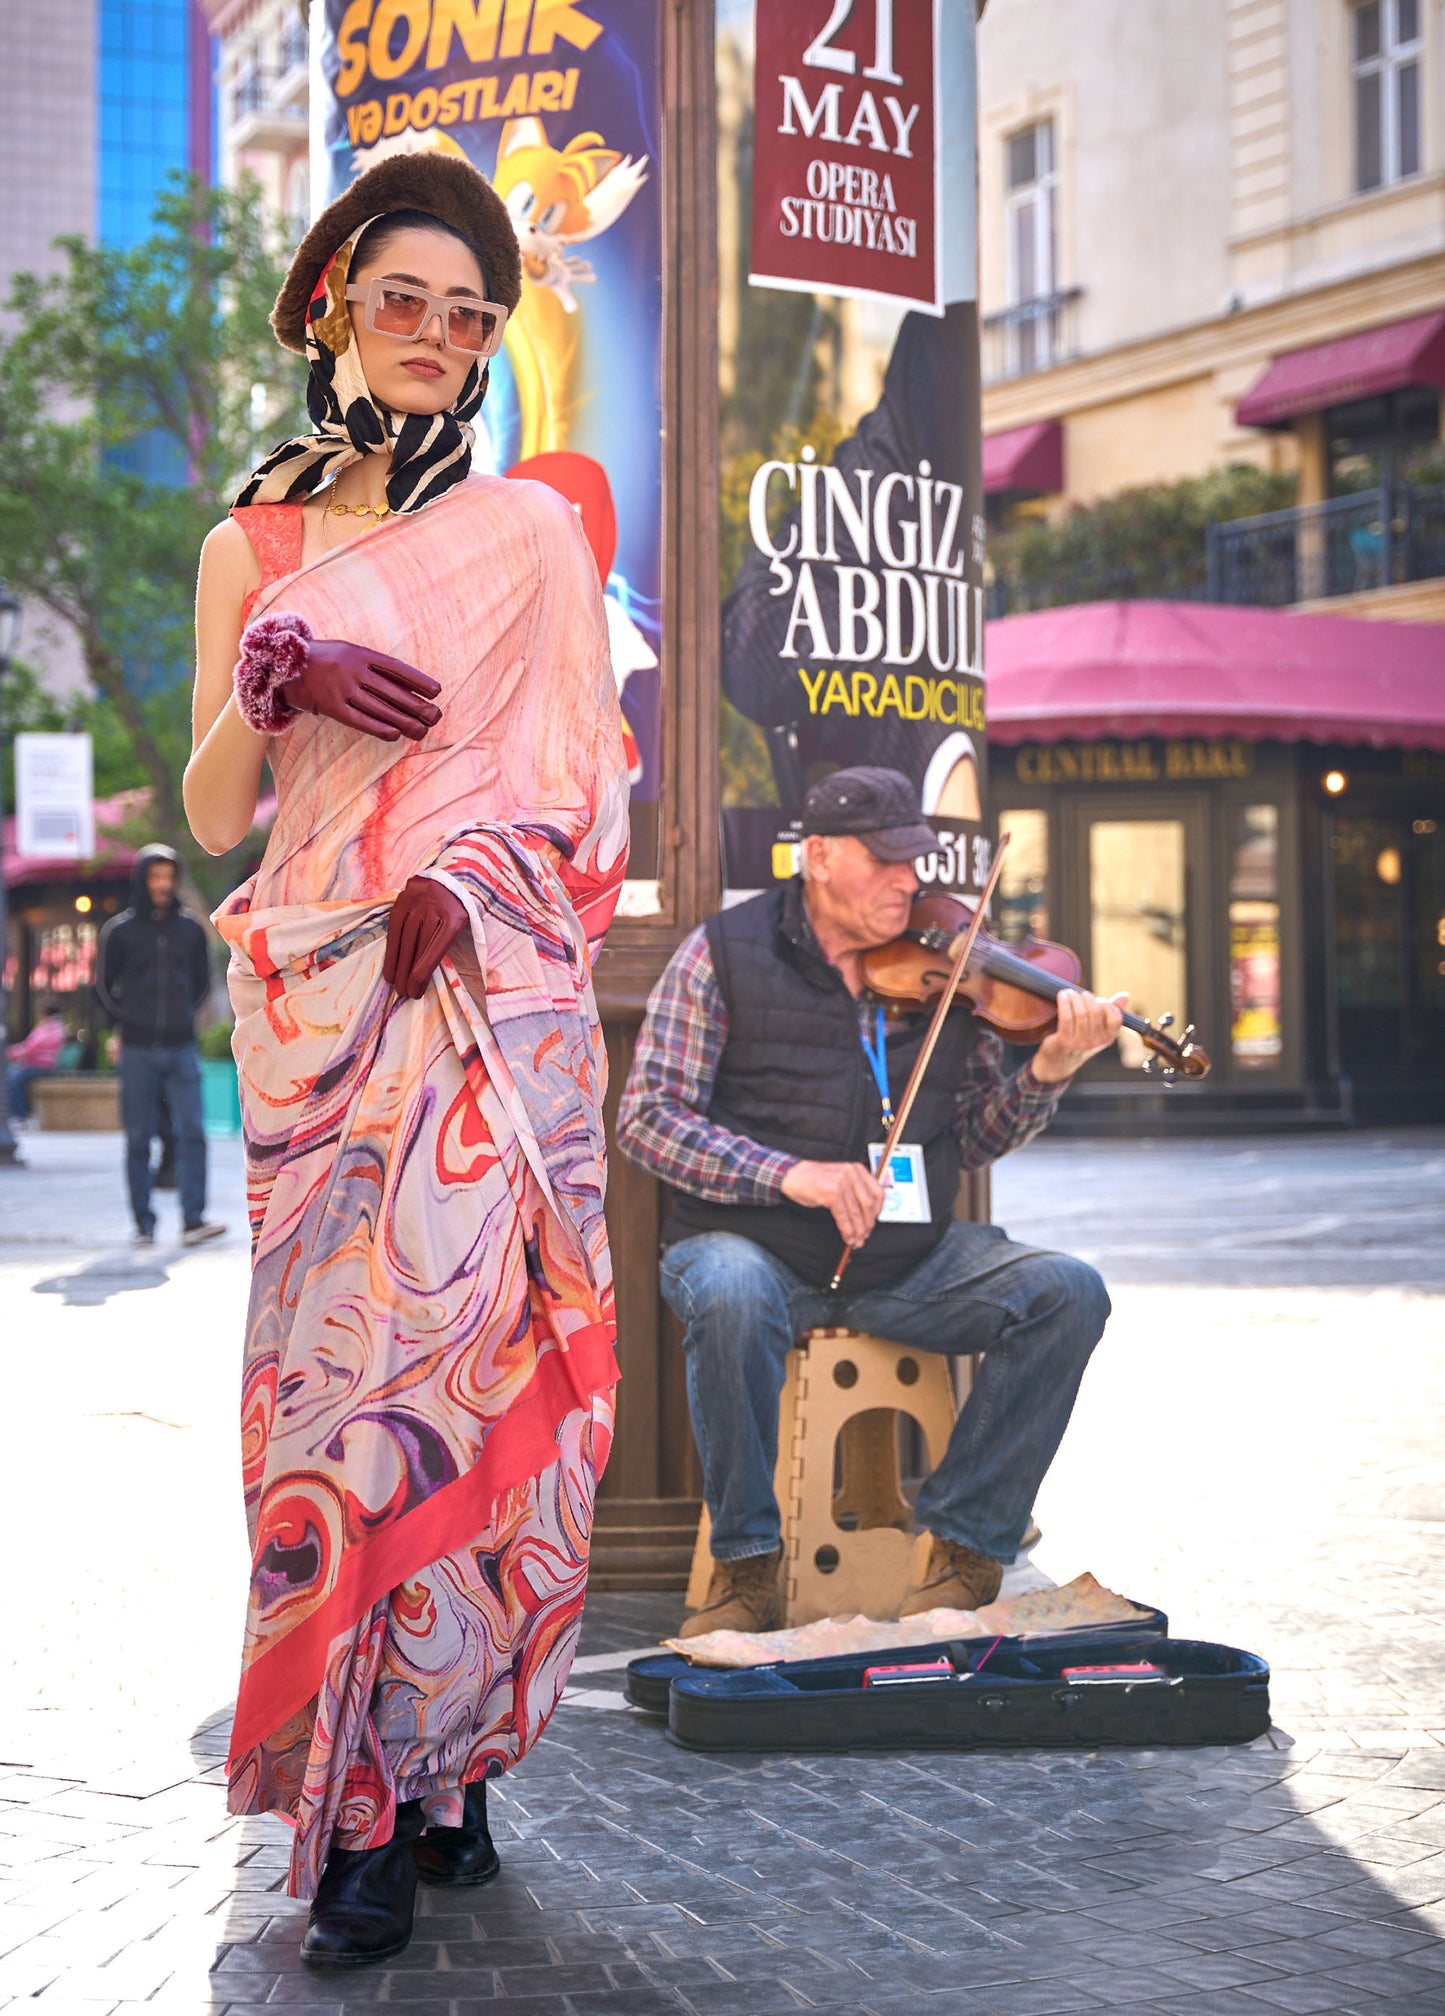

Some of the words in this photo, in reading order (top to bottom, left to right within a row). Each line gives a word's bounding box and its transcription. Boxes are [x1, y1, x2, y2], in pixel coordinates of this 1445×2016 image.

[802, 0, 904, 86] 21
[382, 67, 580, 138] DOSTLARI
[777, 74, 920, 158] MAY
[806, 159, 897, 213] OPERA
[779, 196, 917, 258] STUDIYASI
[748, 444, 964, 596] ÇİNGİZ
